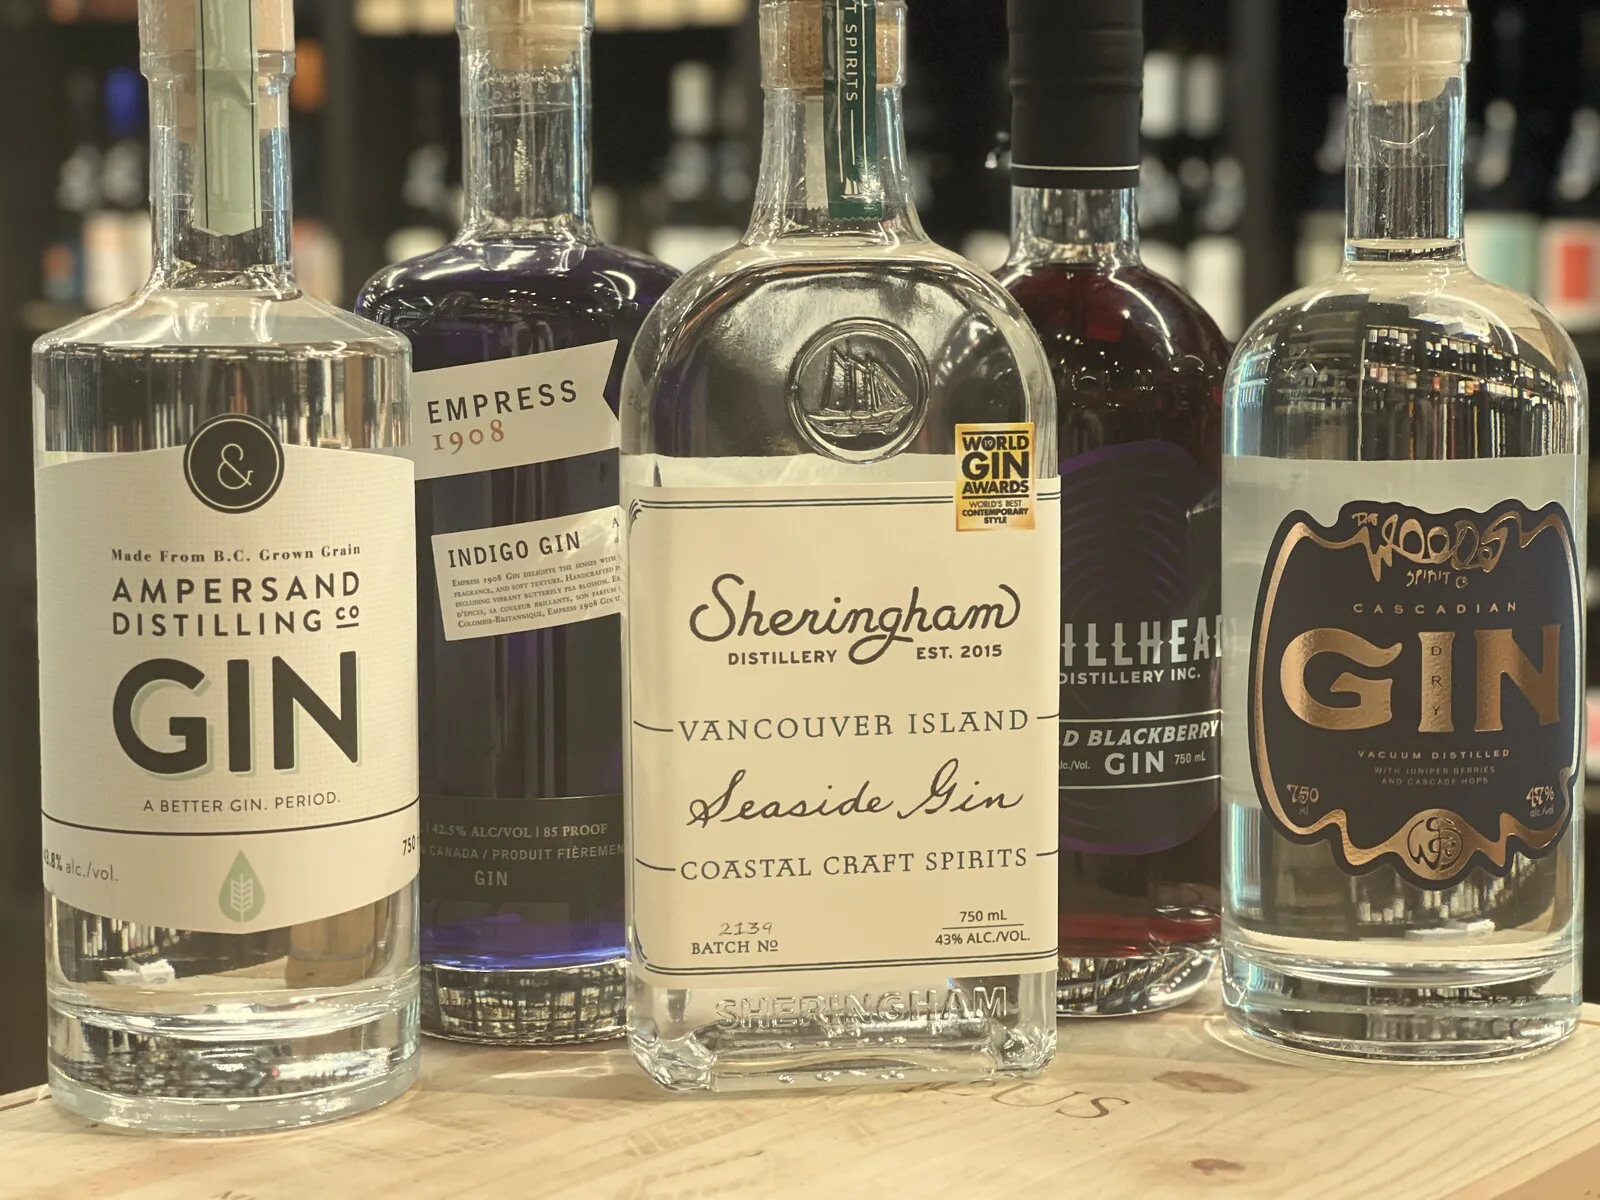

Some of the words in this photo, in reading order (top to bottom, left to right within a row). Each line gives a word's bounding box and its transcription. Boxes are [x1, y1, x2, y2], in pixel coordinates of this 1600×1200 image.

[845, 24, 858, 102] SPIRITS
[427, 379, 577, 424] EMPRESS
[432, 419, 504, 455] 1908
[962, 435, 1030, 452] WORLD
[217, 443, 254, 490] &
[961, 451, 1029, 480] GIN
[962, 480, 1029, 494] AWARDS
[962, 507, 1029, 517] CONTEMPORARY
[969, 500, 1002, 508] WORLD'S
[1005, 499, 1022, 507] BEST
[984, 516, 1007, 524] STYLE
[112, 549, 152, 562] Made
[160, 550, 205, 563] From
[213, 550, 251, 562] B.C.
[259, 548, 314, 562] Grown
[321, 543, 361, 558] Grain
[448, 540, 529, 568] INDIGO
[539, 531, 580, 555] GIN
[483, 574, 502, 584] 1908
[559, 564, 572, 572] THE
[112, 571, 360, 603] AMPERSAND
[495, 585, 510, 593] AND
[579, 600, 598, 610] 1908
[1353, 601, 1517, 614] CASCADIAN
[113, 608, 322, 637] DISTILLING
[689, 572, 1021, 665] Sheringham
[728, 649, 838, 666] DISTILLERY
[916, 647, 953, 660] EST.
[961, 644, 1003, 660] 2015
[1059, 670, 1164, 685] DISTILLERY
[1171, 667, 1201, 682] INC.
[1280, 624, 1561, 732] GIN
[1430, 646, 1443, 716] DRY
[113, 651, 361, 778] GIN
[677, 714, 894, 742] VANCOUVER
[908, 709, 1029, 735] ISLAND
[1059, 730, 1079, 747] D
[1087, 719, 1220, 747] BLACKBERRY
[1104, 750, 1164, 775] GIN
[1174, 753, 1192, 765] 750
[1194, 751, 1206, 762] mL
[1358, 750, 1421, 760] VACUUM
[1432, 749, 1510, 760] DISTILLED
[1374, 766, 1401, 774] WITH
[1406, 767, 1449, 775] JUNIPER
[1453, 766, 1496, 775] BERRIES
[1382, 777, 1403, 786] AND
[1407, 777, 1456, 786] CASCADE
[1461, 777, 1489, 785] HOPS
[143, 800, 154, 812] A
[160, 799, 223, 813] BETTER
[230, 797, 268, 812] GIN.
[275, 791, 341, 810] PERIOD.
[686, 768, 894, 829] Seaside
[896, 757, 1023, 820] Gin
[1287, 784, 1319, 804] 750
[1526, 785, 1555, 807] 47%
[432, 823, 467, 837] 42.5%
[471, 826, 531, 838] ALC/VOL
[543, 826, 558, 838] 85
[562, 823, 608, 837] PROOF
[402, 834, 416, 856] 750
[429, 846, 479, 859] CANADA
[493, 849, 552, 861] PRODUIT
[66, 858, 119, 882] alc./vol.
[680, 857, 812, 881] COASTAL
[823, 852, 915, 875] CRAFT
[925, 847, 1028, 872] SPIRITS
[474, 870, 508, 887] GIN
[959, 910, 983, 922] 750
[987, 909, 1008, 921] mL
[719, 920, 774, 937] 2139
[935, 932, 963, 946] 43%
[966, 930, 1031, 945] ALC./VOL.
[691, 940, 750, 956] BATCH
[716, 986, 1008, 1030] SHERINGHAM
